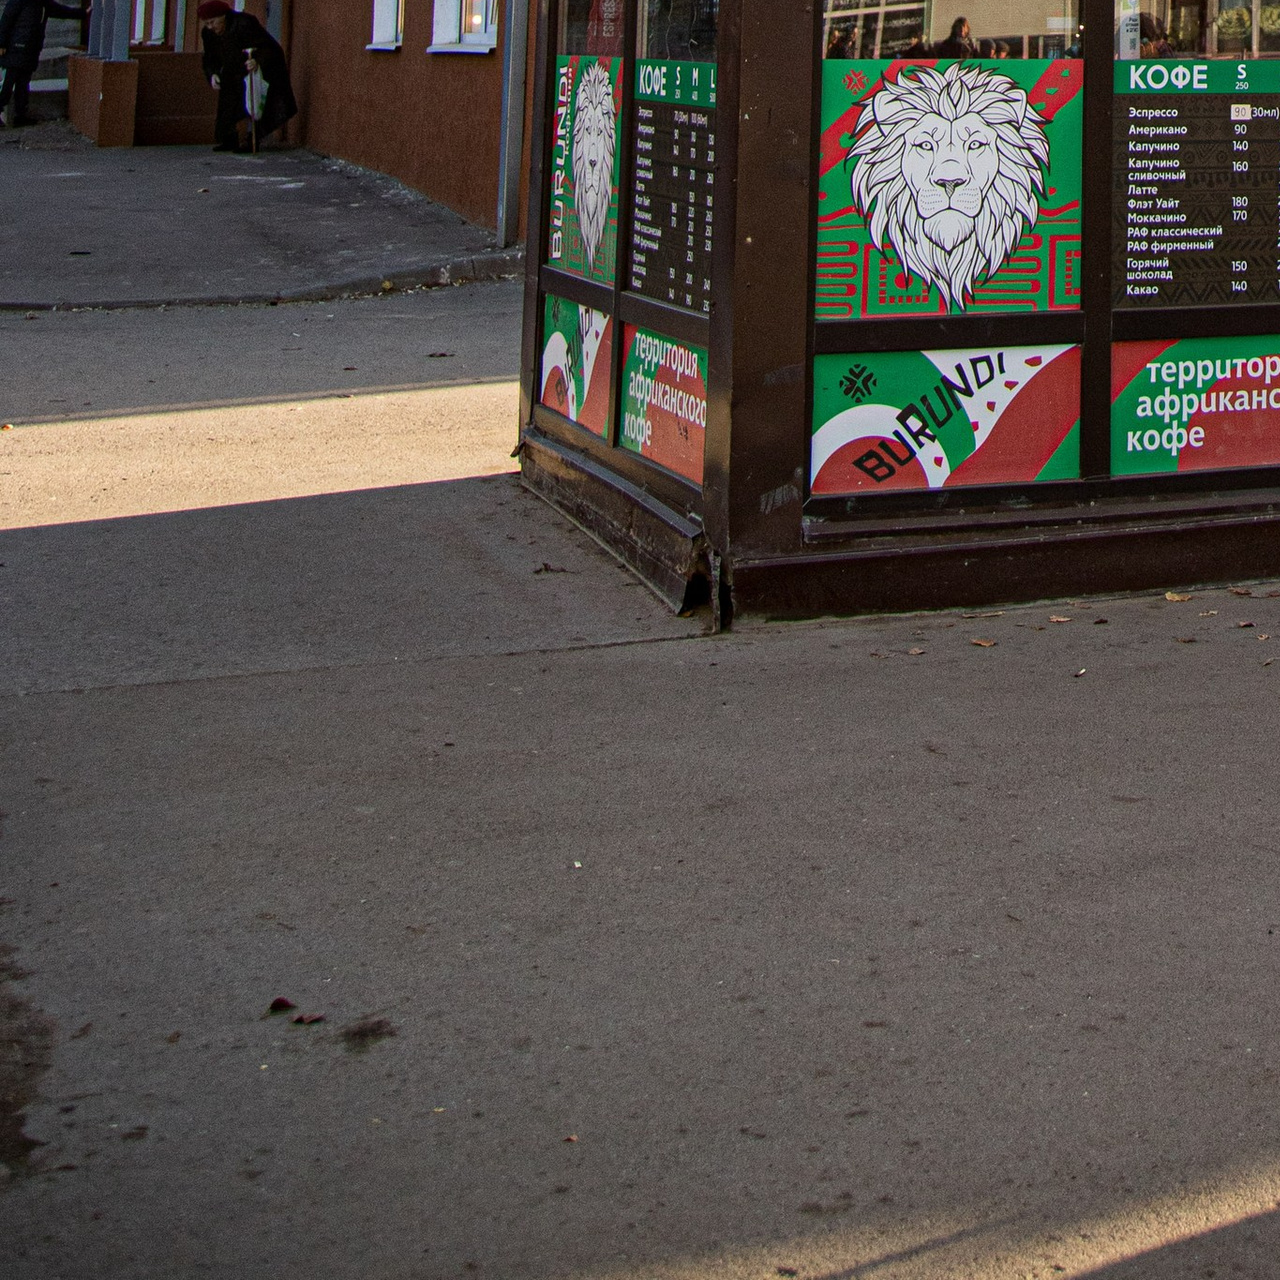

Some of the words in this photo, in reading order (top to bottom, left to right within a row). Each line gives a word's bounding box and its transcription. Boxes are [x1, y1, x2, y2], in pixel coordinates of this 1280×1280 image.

[640, 65, 667, 96] КОФЕ
[676, 66, 681, 85] S
[692, 67, 699, 86] M
[711, 68, 716, 88] L
[1130, 64, 1208, 89] КОФЕ
[1237, 64, 1247, 79] S
[1235, 82, 1249, 90] 250
[1128, 107, 1178, 120] Эспрессо
[1128, 125, 1188, 137] Американо
[1234, 124, 1247, 134] 90
[1128, 141, 1180, 153] Капучино
[1233, 141, 1248, 151] 140
[552, 66, 568, 258] BURUNDI
[1128, 158, 1180, 170] Капучино
[1232, 161, 1248, 171] 160
[1128, 170, 1186, 181] сливочный
[1128, 186, 1158, 195] Латте
[1127, 199, 1154, 209] Флэт
[1156, 198, 1180, 209] Уайт
[1232, 197, 1248, 207] 180
[1127, 213, 1187, 224] Моккачино
[1232, 210, 1248, 221] 170
[1127, 227, 1149, 238] РАФ
[1151, 225, 1223, 237] классический
[1127, 241, 1149, 252] РАФ
[1151, 239, 1214, 253] фирменный
[1127, 257, 1169, 269] Горячий
[1232, 261, 1247, 271] 150
[1127, 270, 1173, 281] шоколад
[1127, 285, 1158, 295] Какао
[1232, 281, 1247, 291] 140
[635, 332, 698, 383] территория
[629, 364, 707, 428] африканского
[853, 351, 1006, 483] BURUNDI
[624, 407, 652, 453] кофе
[1126, 420, 1206, 456] кофе
